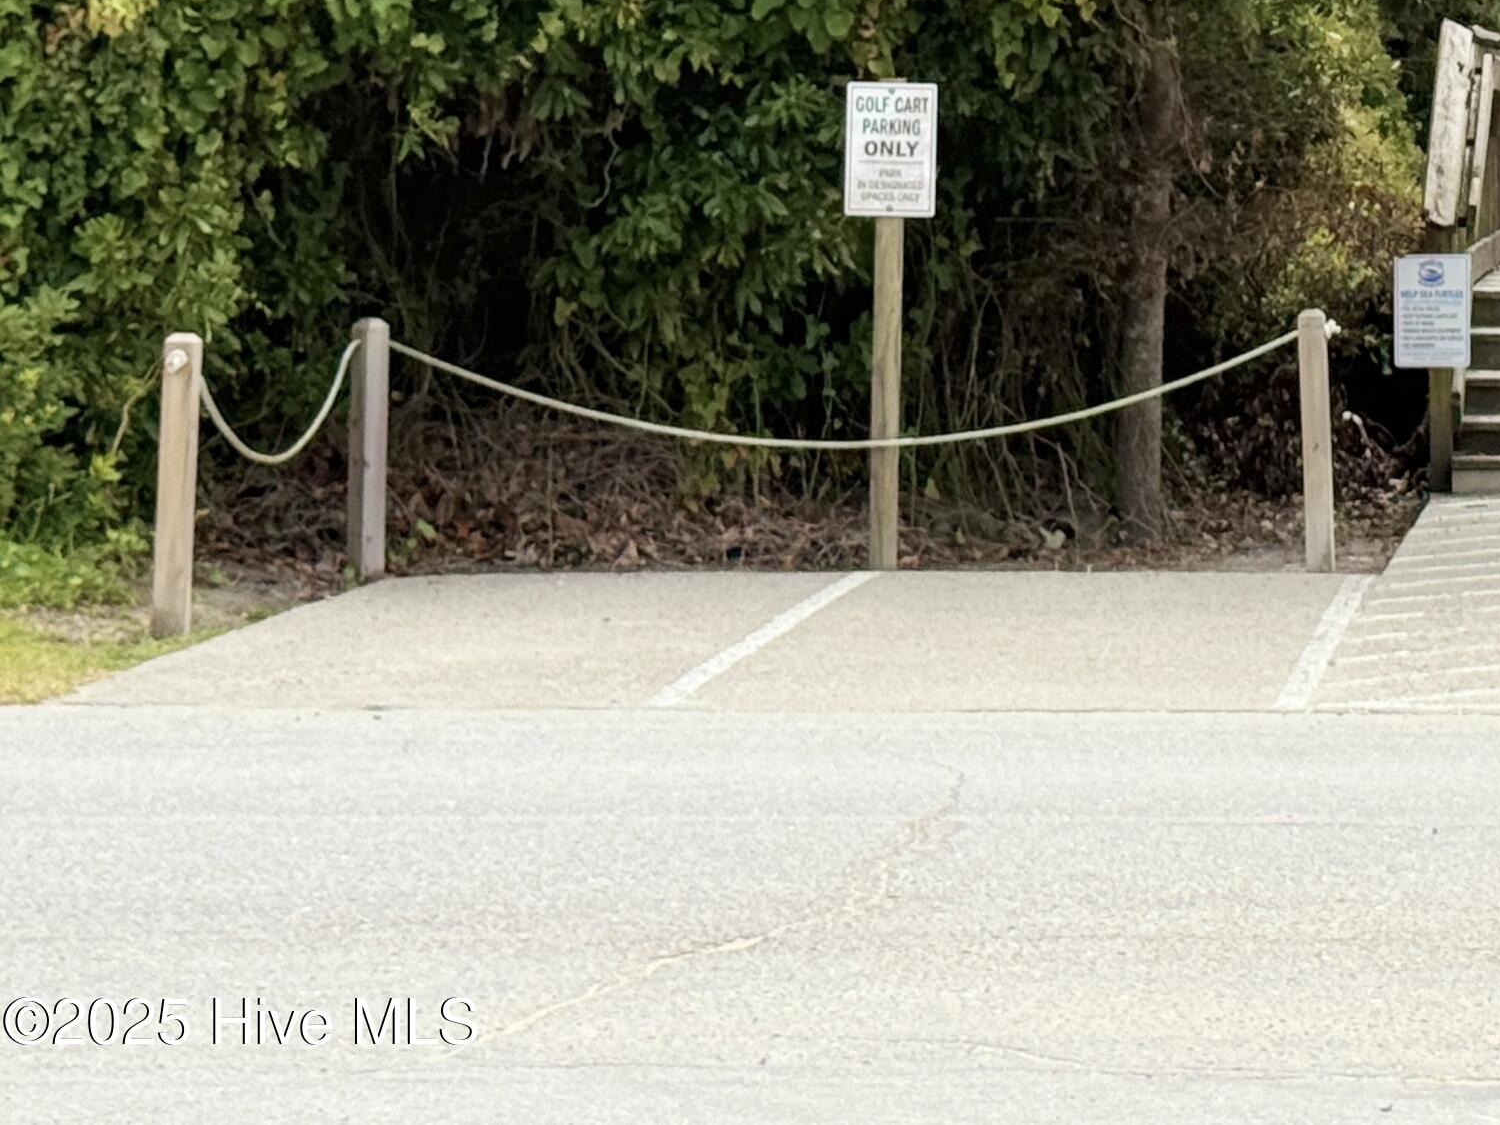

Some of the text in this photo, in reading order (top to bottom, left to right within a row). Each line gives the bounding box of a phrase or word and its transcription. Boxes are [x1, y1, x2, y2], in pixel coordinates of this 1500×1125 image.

[855, 96, 929, 114] GOLF CART
[862, 118, 921, 136] PARKING
[864, 140, 919, 157] ONLY
